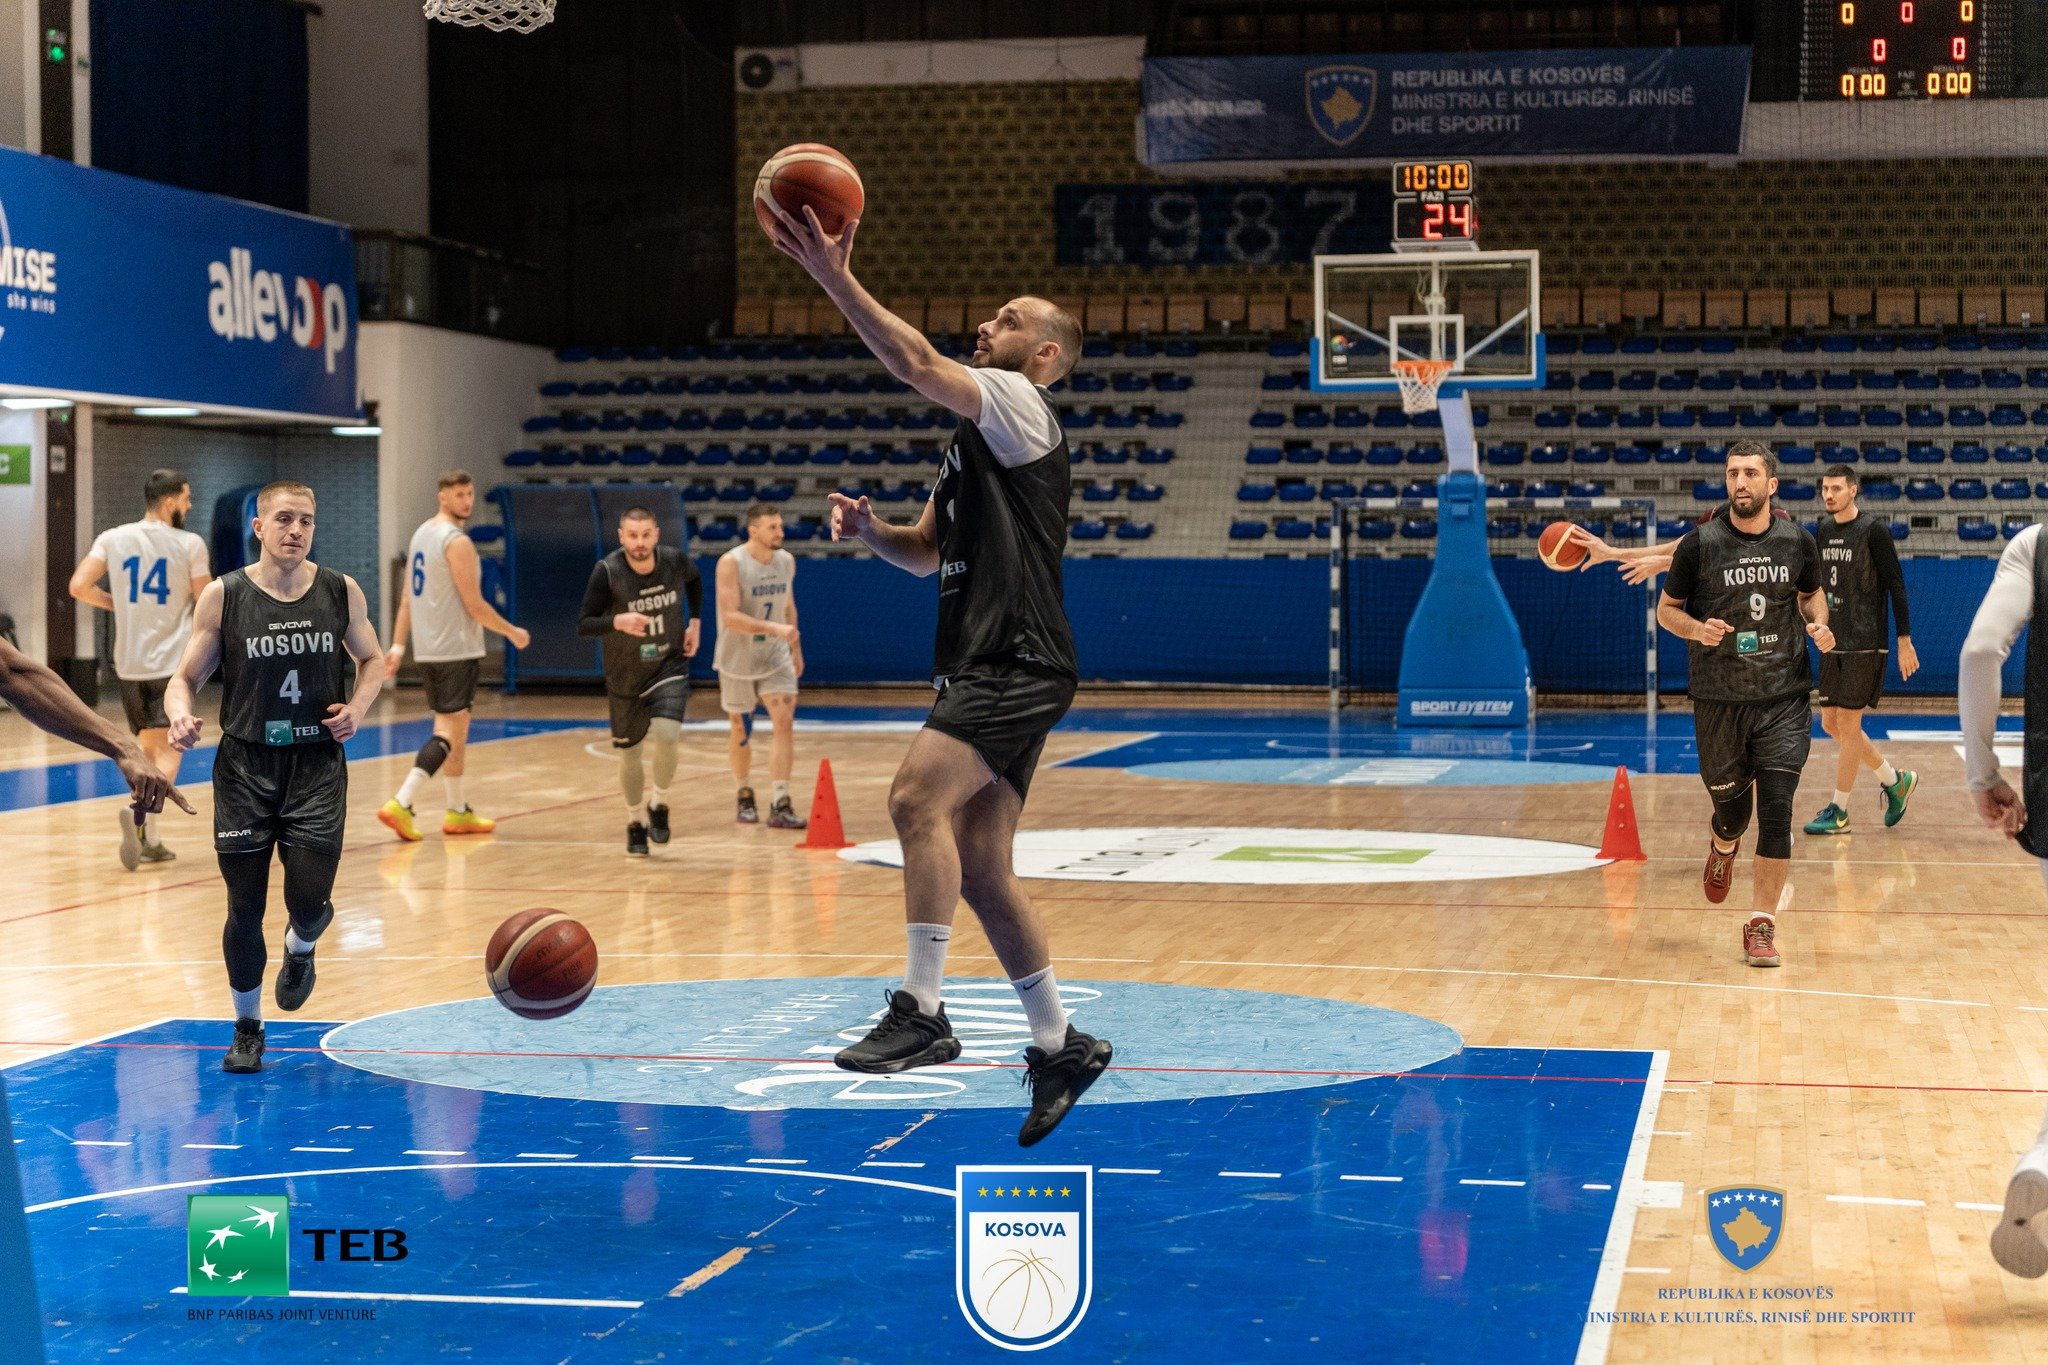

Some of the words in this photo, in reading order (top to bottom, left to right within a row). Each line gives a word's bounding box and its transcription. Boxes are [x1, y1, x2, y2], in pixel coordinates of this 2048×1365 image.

[1842, 2, 1854, 25] 0
[1901, 1, 1913, 23] 0
[1961, 0, 1973, 22] 0
[1873, 38, 1886, 62] 0
[1953, 37, 1966, 60] 0
[1392, 69, 1504, 87] REPUBLIKA
[1511, 69, 1522, 85] E
[1529, 65, 1626, 84] KOSOVËS
[1393, 93, 1493, 111] MINISTRIA
[1496, 92, 1507, 108] E
[1392, 116, 1432, 134] DHE
[1439, 113, 1522, 133] SPORTIT
[1404, 164, 1469, 190] 10:00
[1421, 191, 1444, 201] FAZI
[1423, 203, 1470, 240] 24
[1822, 548, 1852, 562] KOSOVA
[122, 554, 170, 605] 14
[412, 552, 425, 597] 6
[1724, 565, 1789, 587] KOSOVA
[1830, 565, 1838, 587] 3
[628, 590, 677, 613] KOSOVA
[763, 602, 773, 620] 7
[1750, 593, 1766, 621] 9
[268, 620, 312, 630] GIVOVA
[649, 614, 664, 637] 11
[246, 631, 334, 659] KOSOVA
[1759, 634, 1778, 644] TEB
[279, 669, 302, 705] 4
[293, 725, 320, 738] TEB
